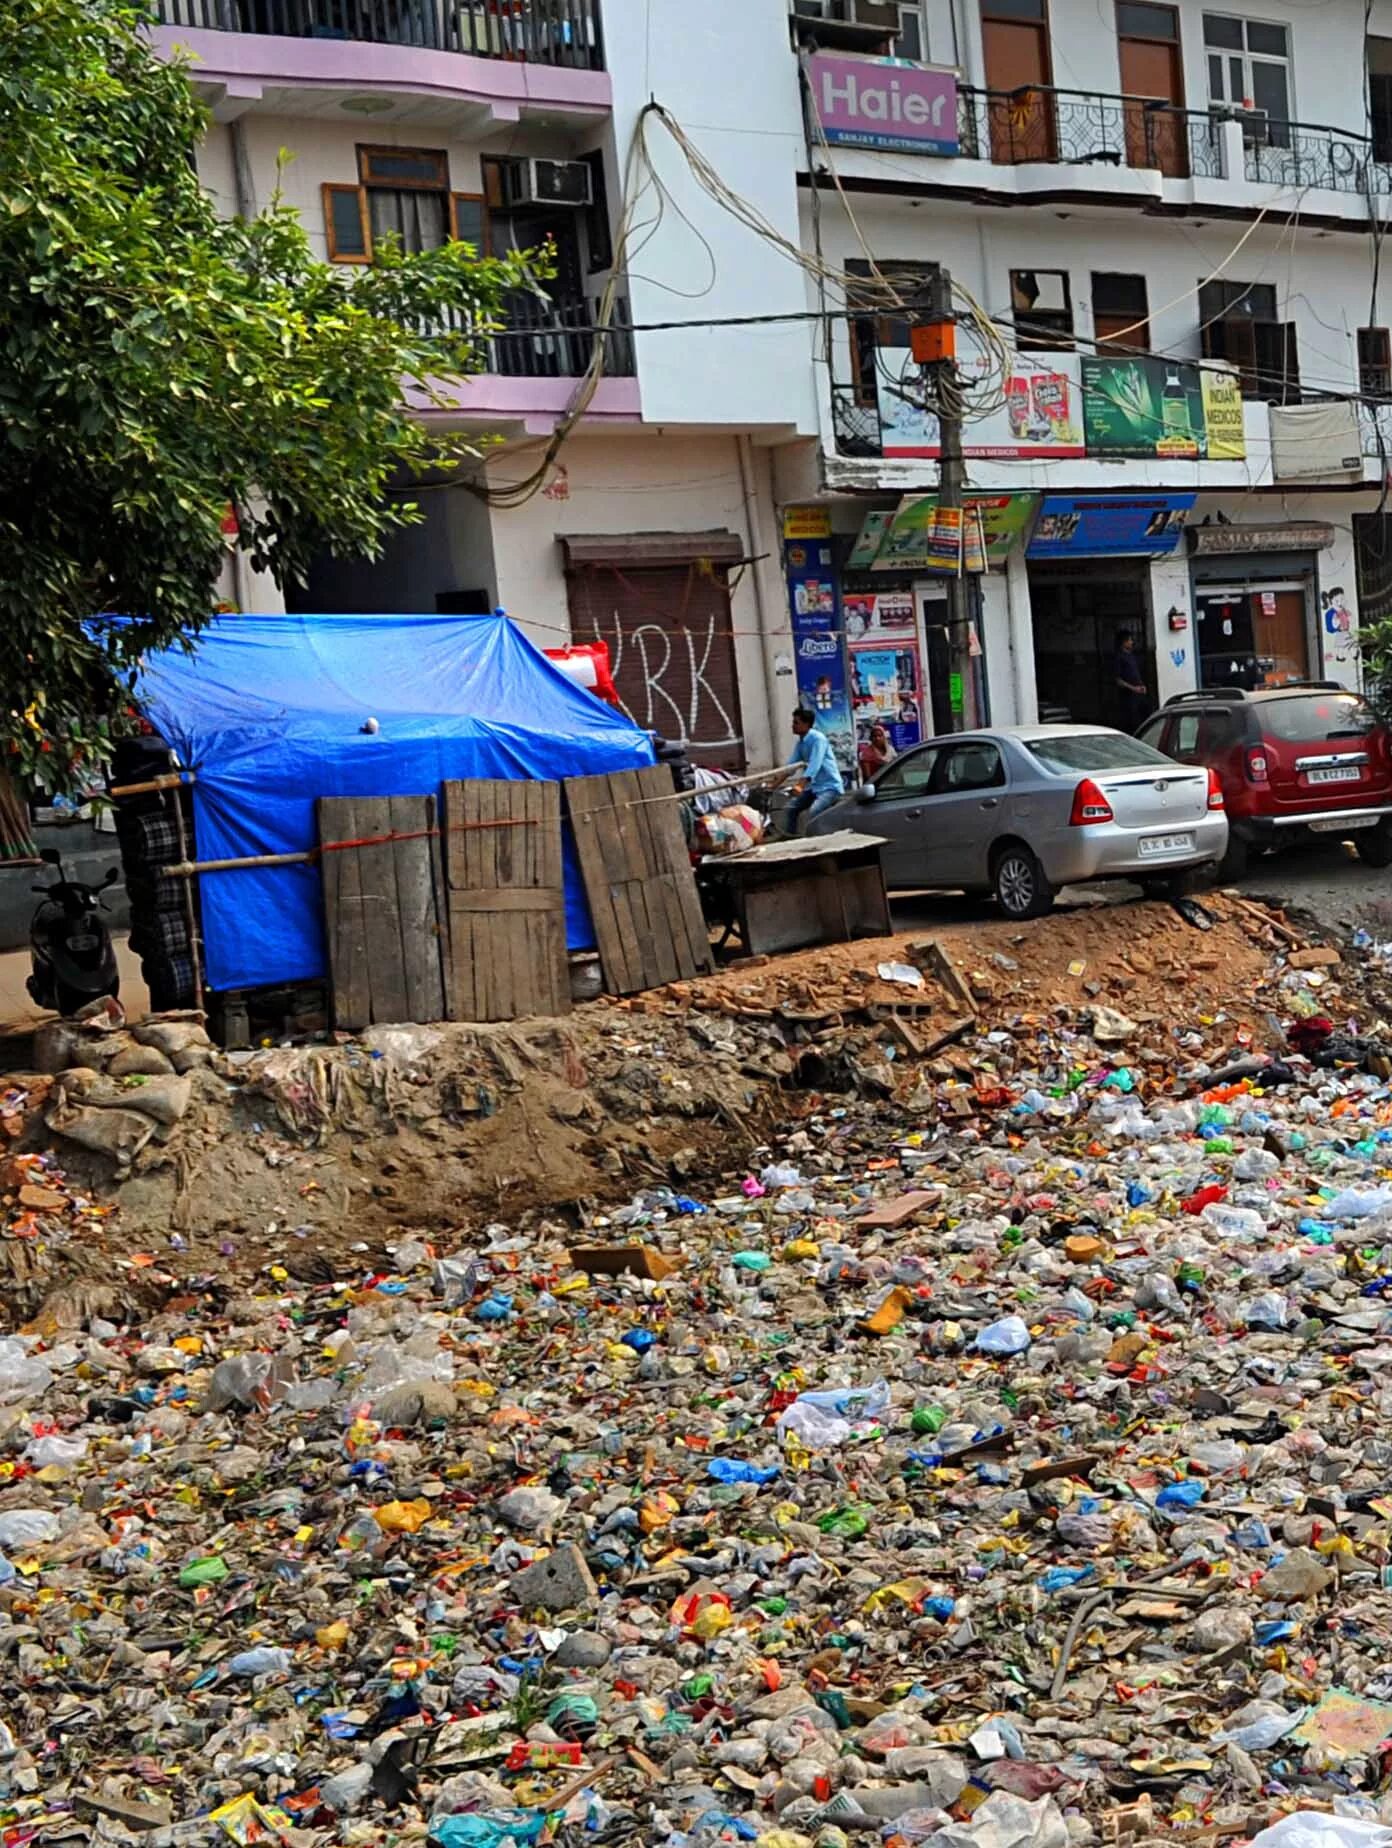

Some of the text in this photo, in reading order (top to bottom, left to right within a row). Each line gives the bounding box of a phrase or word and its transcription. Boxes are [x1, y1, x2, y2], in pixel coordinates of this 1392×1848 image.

[822, 71, 946, 126] Haier
[838, 132, 877, 144] SANJAY
[1209, 389, 1236, 405] INDIAN
[1206, 410, 1242, 425] MEDICOS
